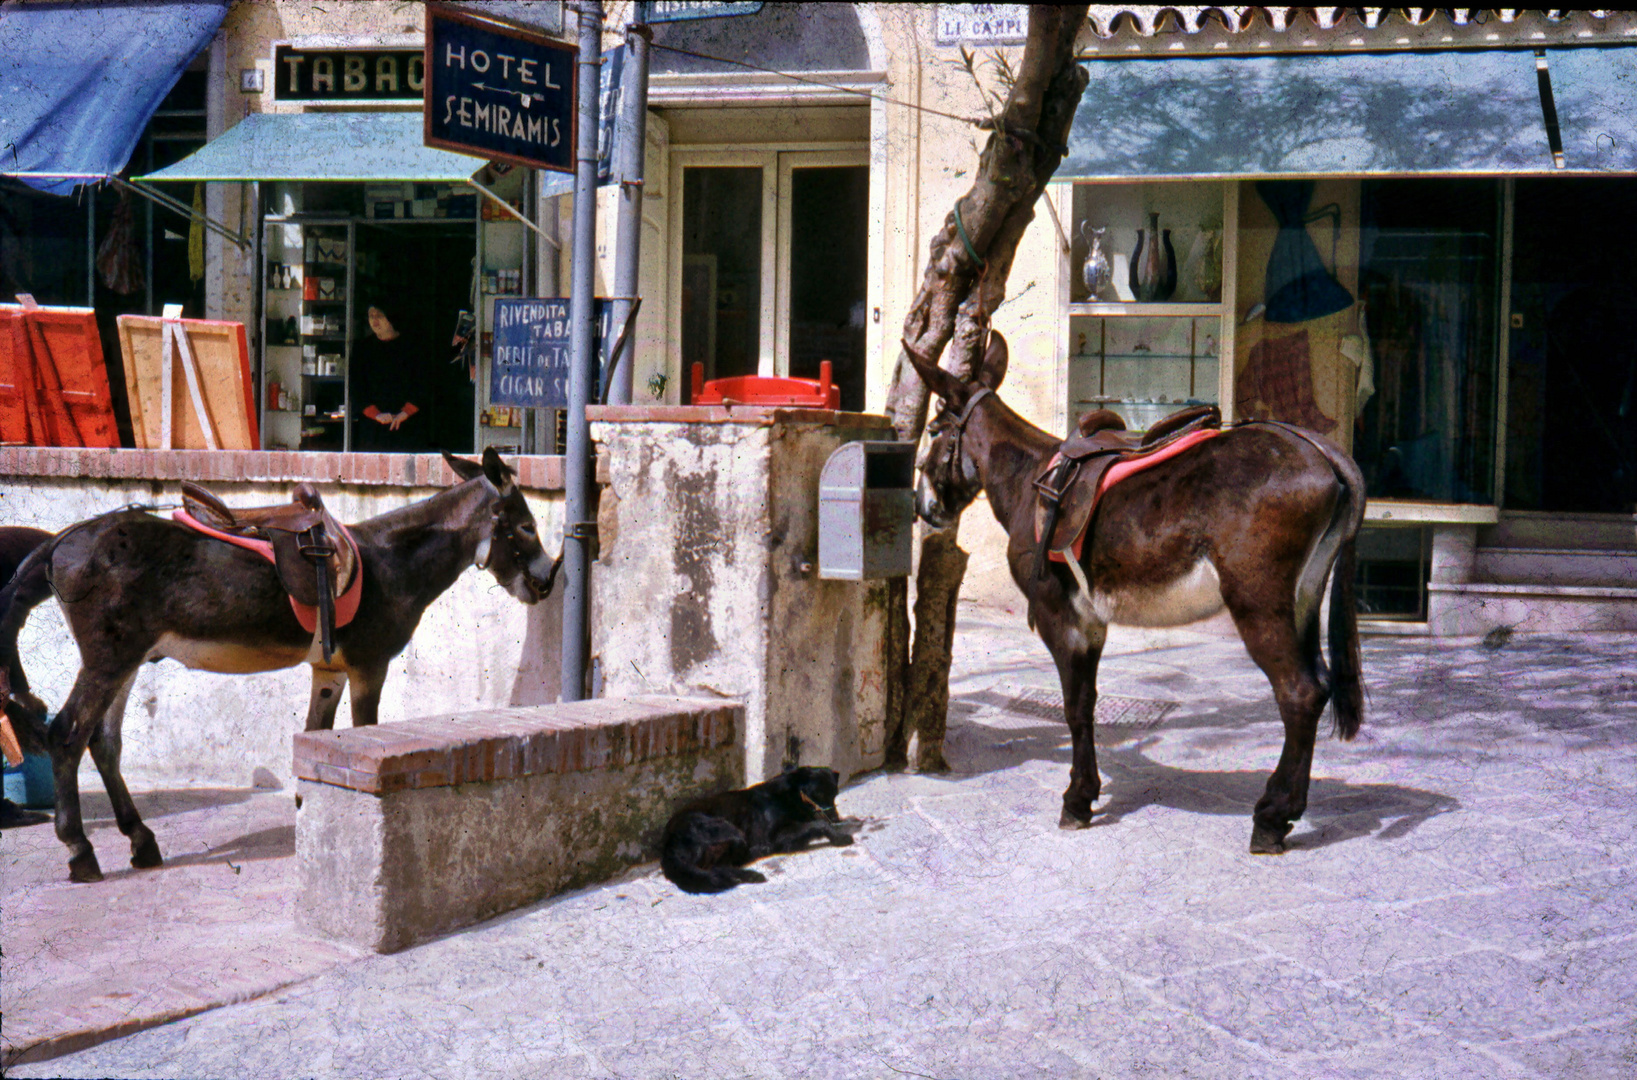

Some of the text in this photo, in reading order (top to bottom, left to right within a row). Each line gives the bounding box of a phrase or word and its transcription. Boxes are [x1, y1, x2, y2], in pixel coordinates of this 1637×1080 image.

[945, 19, 1021, 36] LI CAMPI
[446, 42, 561, 90] HOTEL
[443, 95, 560, 147] SEMIRAMIS
[500, 304, 566, 328] RIVENDITA
[497, 346, 534, 366] DEBIT
[500, 375, 543, 397] CIGAR
